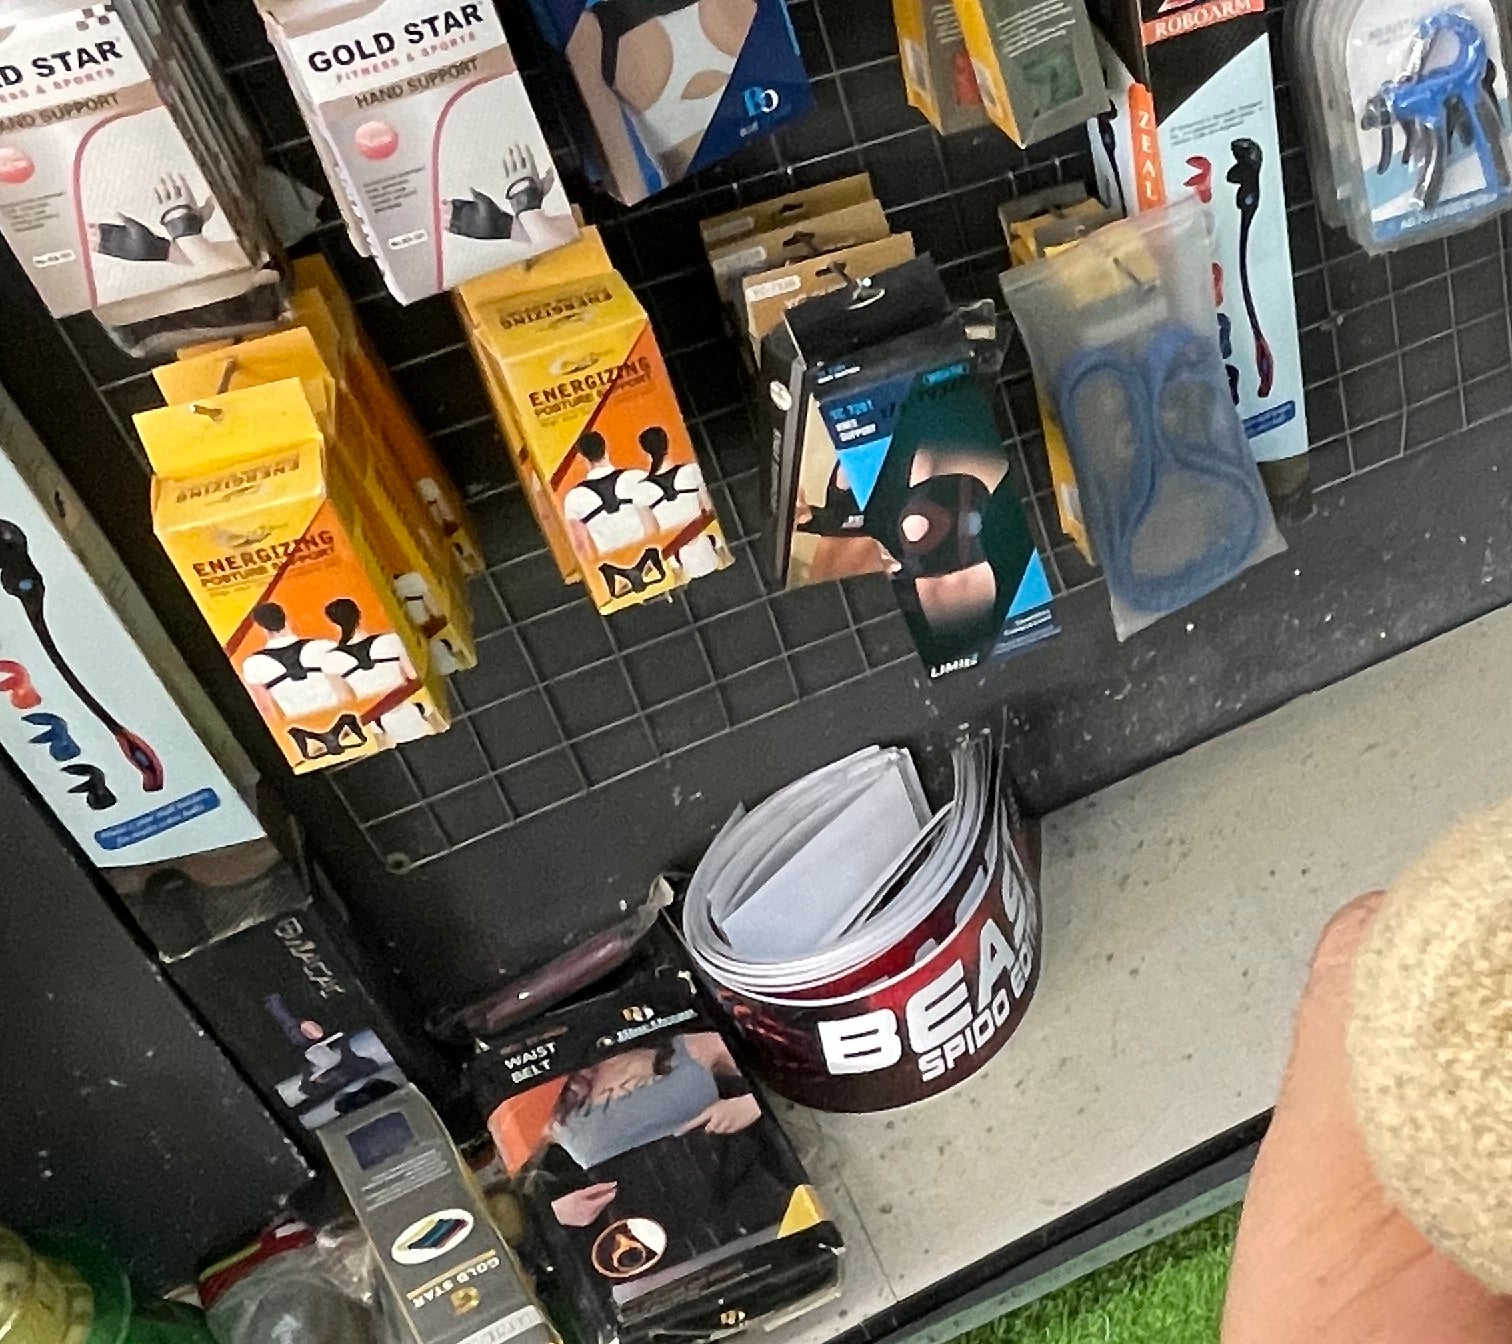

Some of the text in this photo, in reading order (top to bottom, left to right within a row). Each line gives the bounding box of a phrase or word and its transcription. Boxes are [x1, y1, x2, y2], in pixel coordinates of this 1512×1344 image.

[31, 40, 123, 78] STAR
[308, 3, 484, 73] GOLD STAR
[355, 57, 480, 109] HAND SUPPORT
[39, 92, 120, 123] SUPPORT
[1137, 110, 1159, 201] ZEAL
[528, 356, 652, 408] ENERGIZING
[192, 530, 335, 577] ENERGIZING
[504, 1042, 556, 1071] WAIST
[917, 992, 1010, 1082] SPIDO
[510, 1059, 554, 1084] BELT
[412, 1276, 461, 1310] STAR
